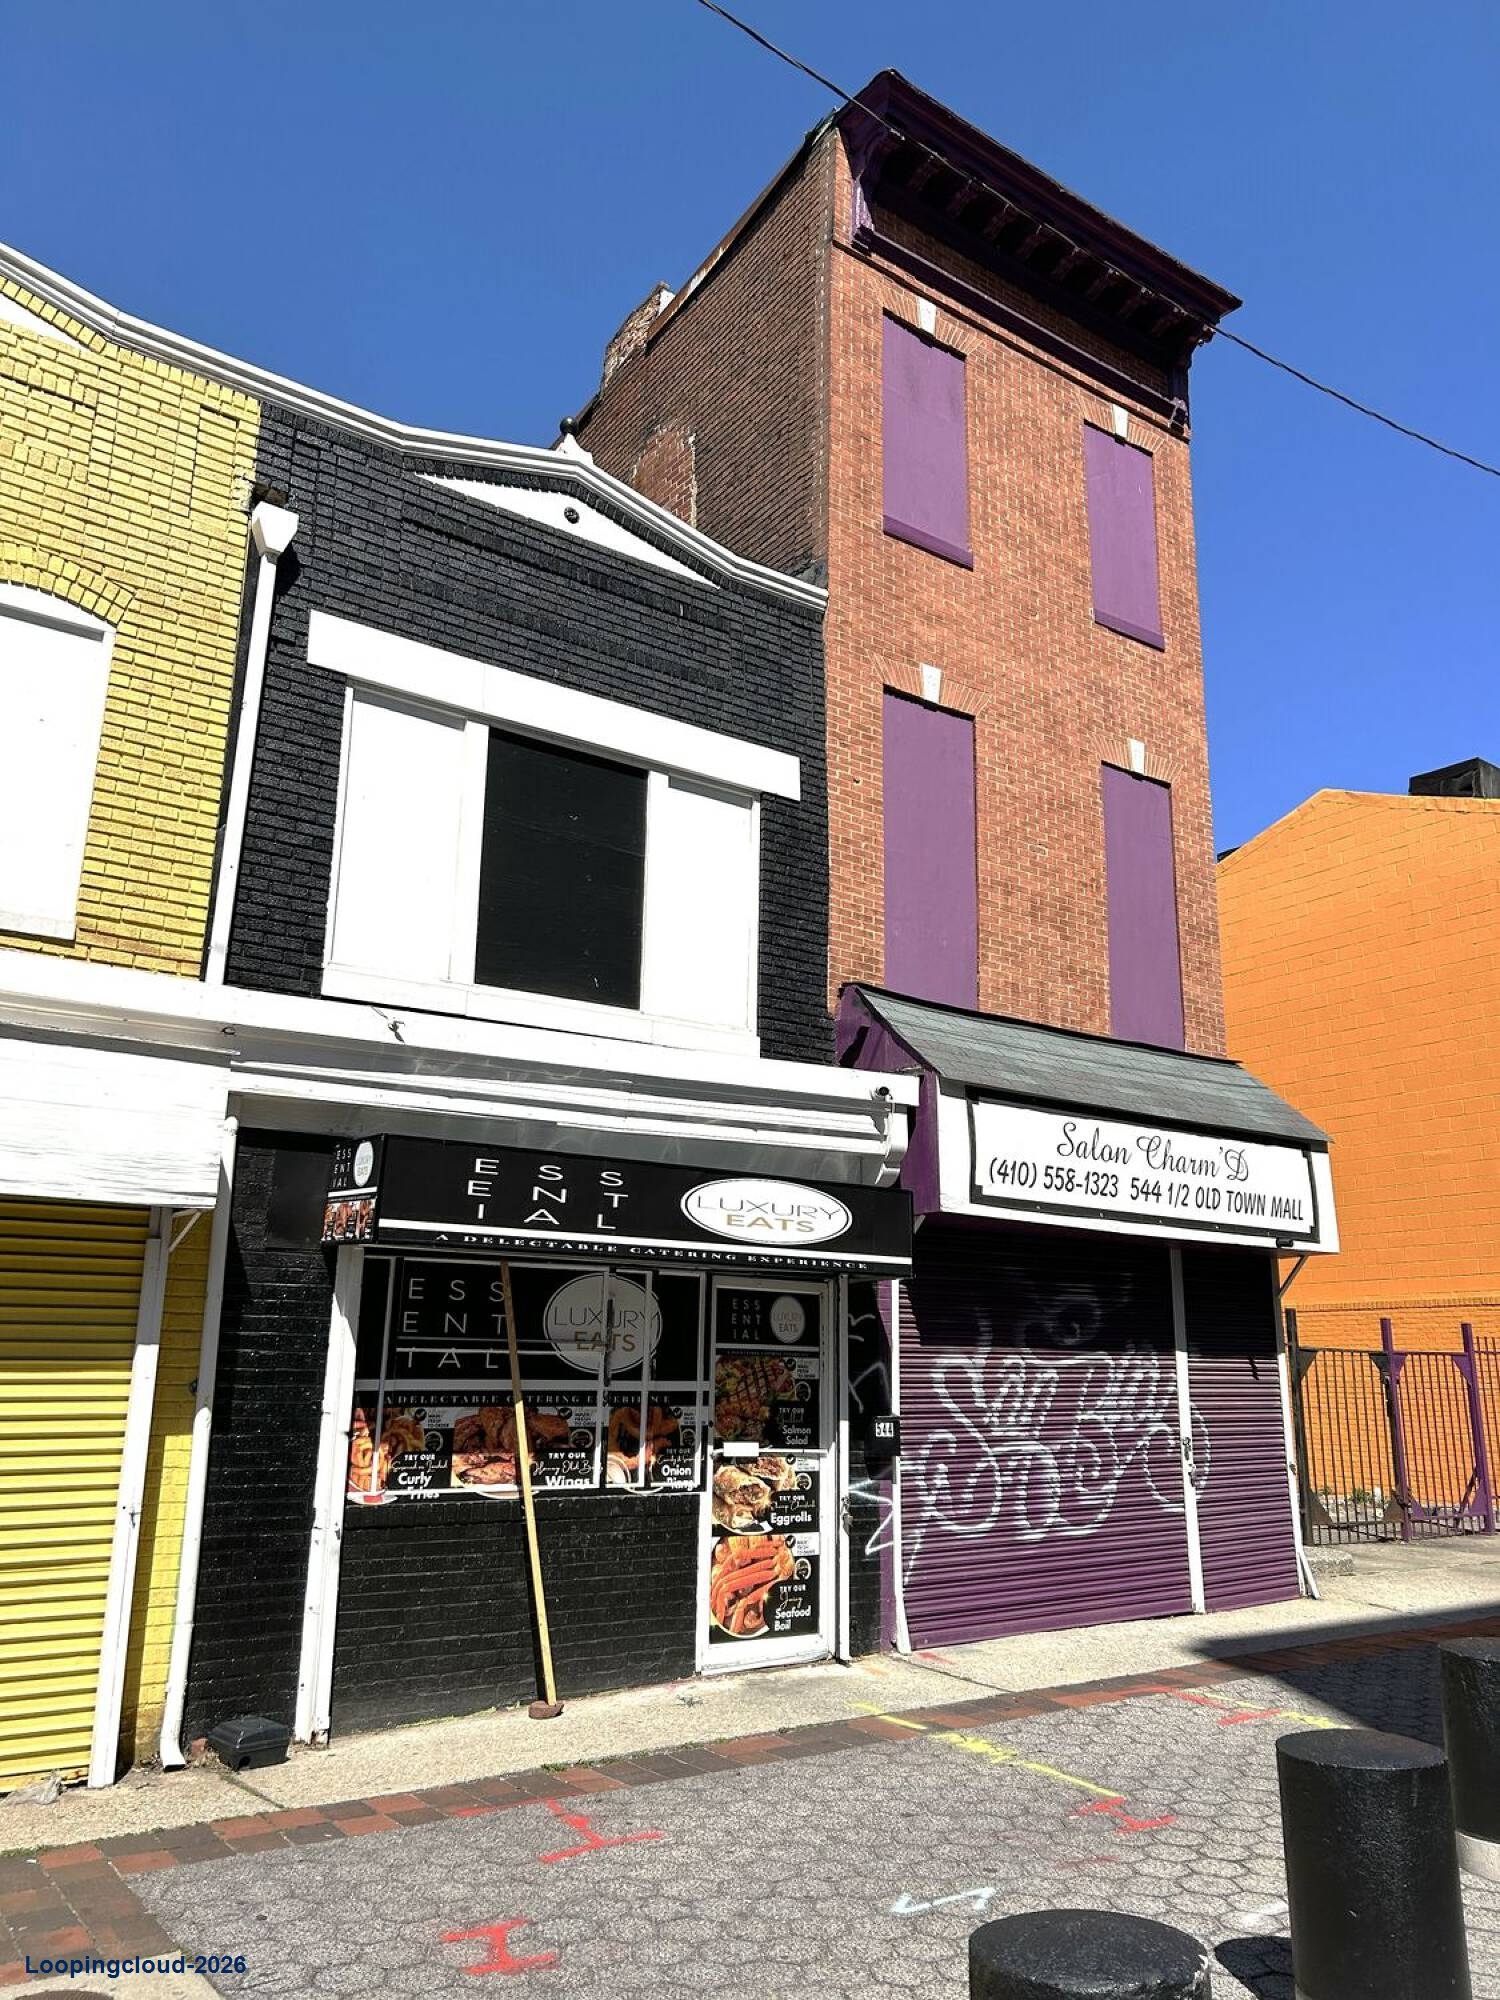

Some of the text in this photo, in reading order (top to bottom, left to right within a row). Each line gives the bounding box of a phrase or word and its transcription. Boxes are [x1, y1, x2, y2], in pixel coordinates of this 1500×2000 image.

[1056, 1122, 1130, 1165] Salon
[988, 1157, 1304, 1221] (410) 558-1323 544 1/2 OLD TOWN MALL
[698, 1194, 842, 1221] LUXURY
[726, 1213, 815, 1234] EATS
[436, 1234, 869, 1270] A DELECTABLE CATERING EXPERIENCE
[574, 1331, 636, 1352] EATS
[506, 1394, 580, 1404] CTERING
[782, 1424, 812, 1435] Salmon
[876, 1423, 893, 1436] 544
[785, 1434, 809, 1445] Salad
[661, 1464, 692, 1477] Onion
[398, 1471, 433, 1487] Curly
[544, 1475, 590, 1489] Wings
[770, 1510, 812, 1526] Eggrolls
[775, 1605, 811, 1619] Seafood
[774, 1619, 792, 1632] Boil
